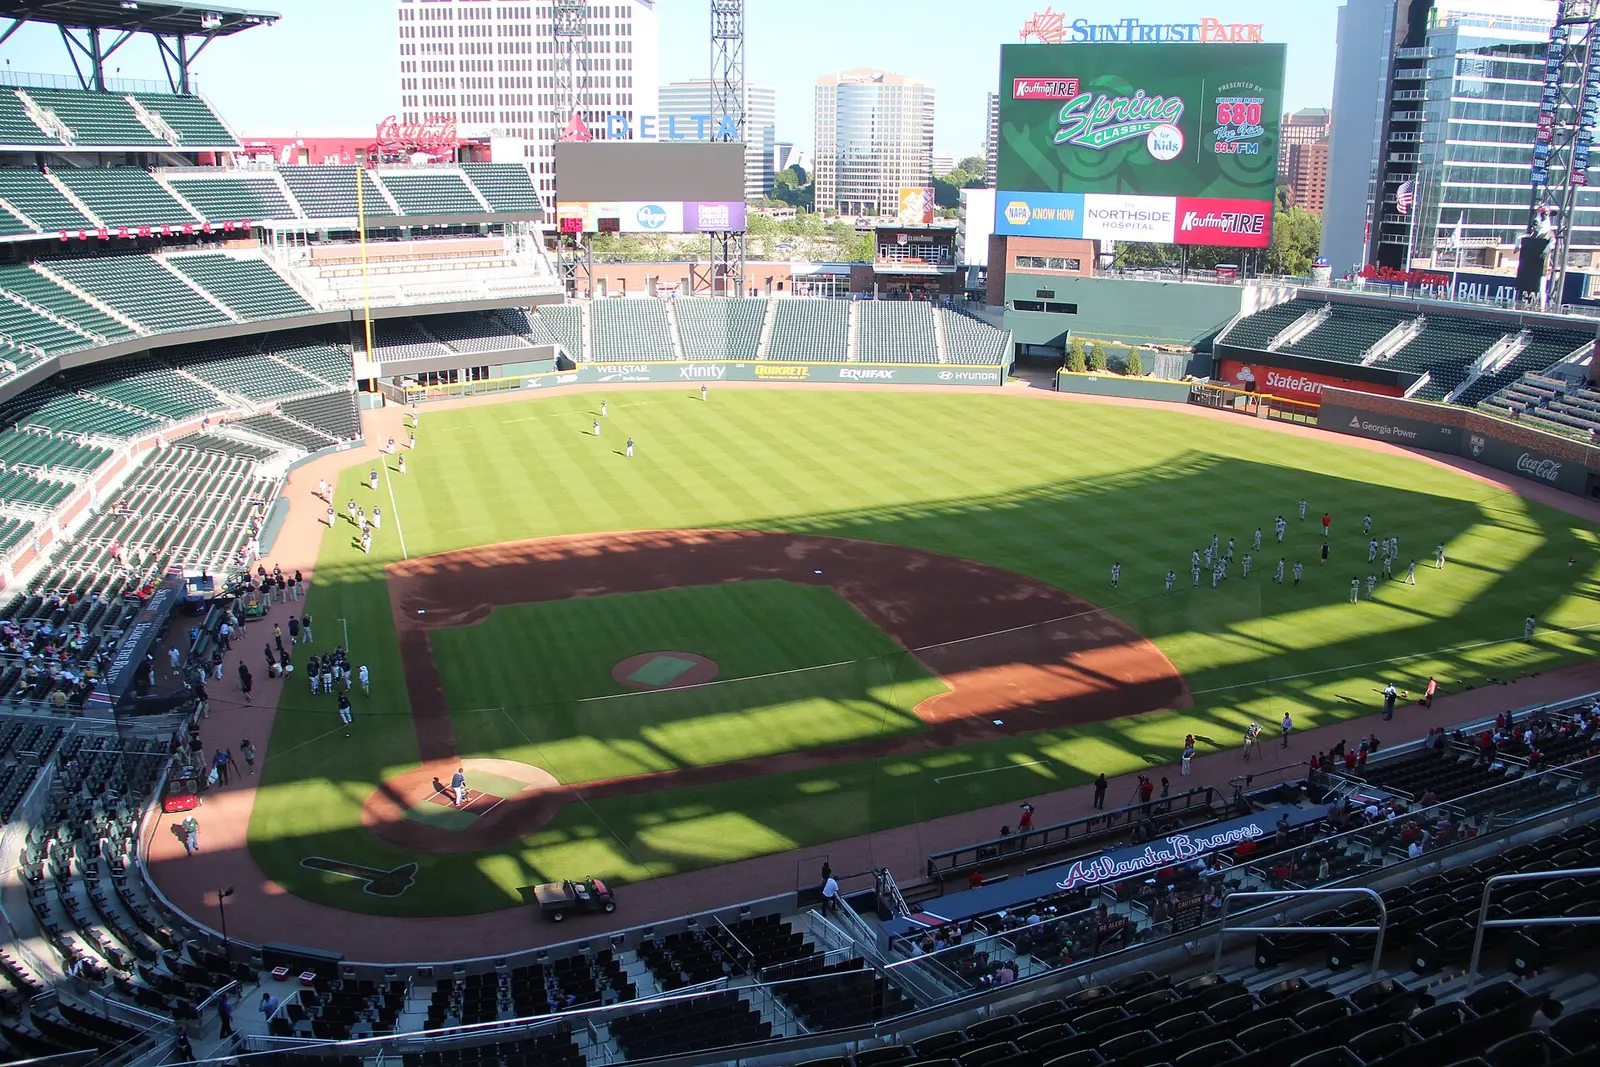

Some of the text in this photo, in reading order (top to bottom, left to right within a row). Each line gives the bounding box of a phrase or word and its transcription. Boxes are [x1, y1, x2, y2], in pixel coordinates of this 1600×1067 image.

[1199, 17, 1265, 43] PARK
[1053, 89, 1184, 145] Spring
[1216, 102, 1261, 126] 680
[607, 115, 740, 139] DELTA
[1094, 123, 1151, 144] CLASSIC
[1153, 139, 1178, 152] Kids
[1008, 207, 1027, 219] NAPA
[1032, 208, 1075, 221] KNOW HOW
[1088, 209, 1171, 222] NORTHSIDE
[1102, 222, 1155, 231] HOSPITAL
[1458, 281, 1489, 306] BALL
[679, 363, 726, 380] xfinity
[755, 365, 811, 376] QUIKRETE
[839, 368, 894, 381] EQUIFAX
[955, 372, 997, 381] HYUNDAI
[1361, 420, 1417, 440] Georgia Power
[1056, 823, 1264, 890] Atlanta Braves
[1177, 896, 1202, 909] CAUTION
